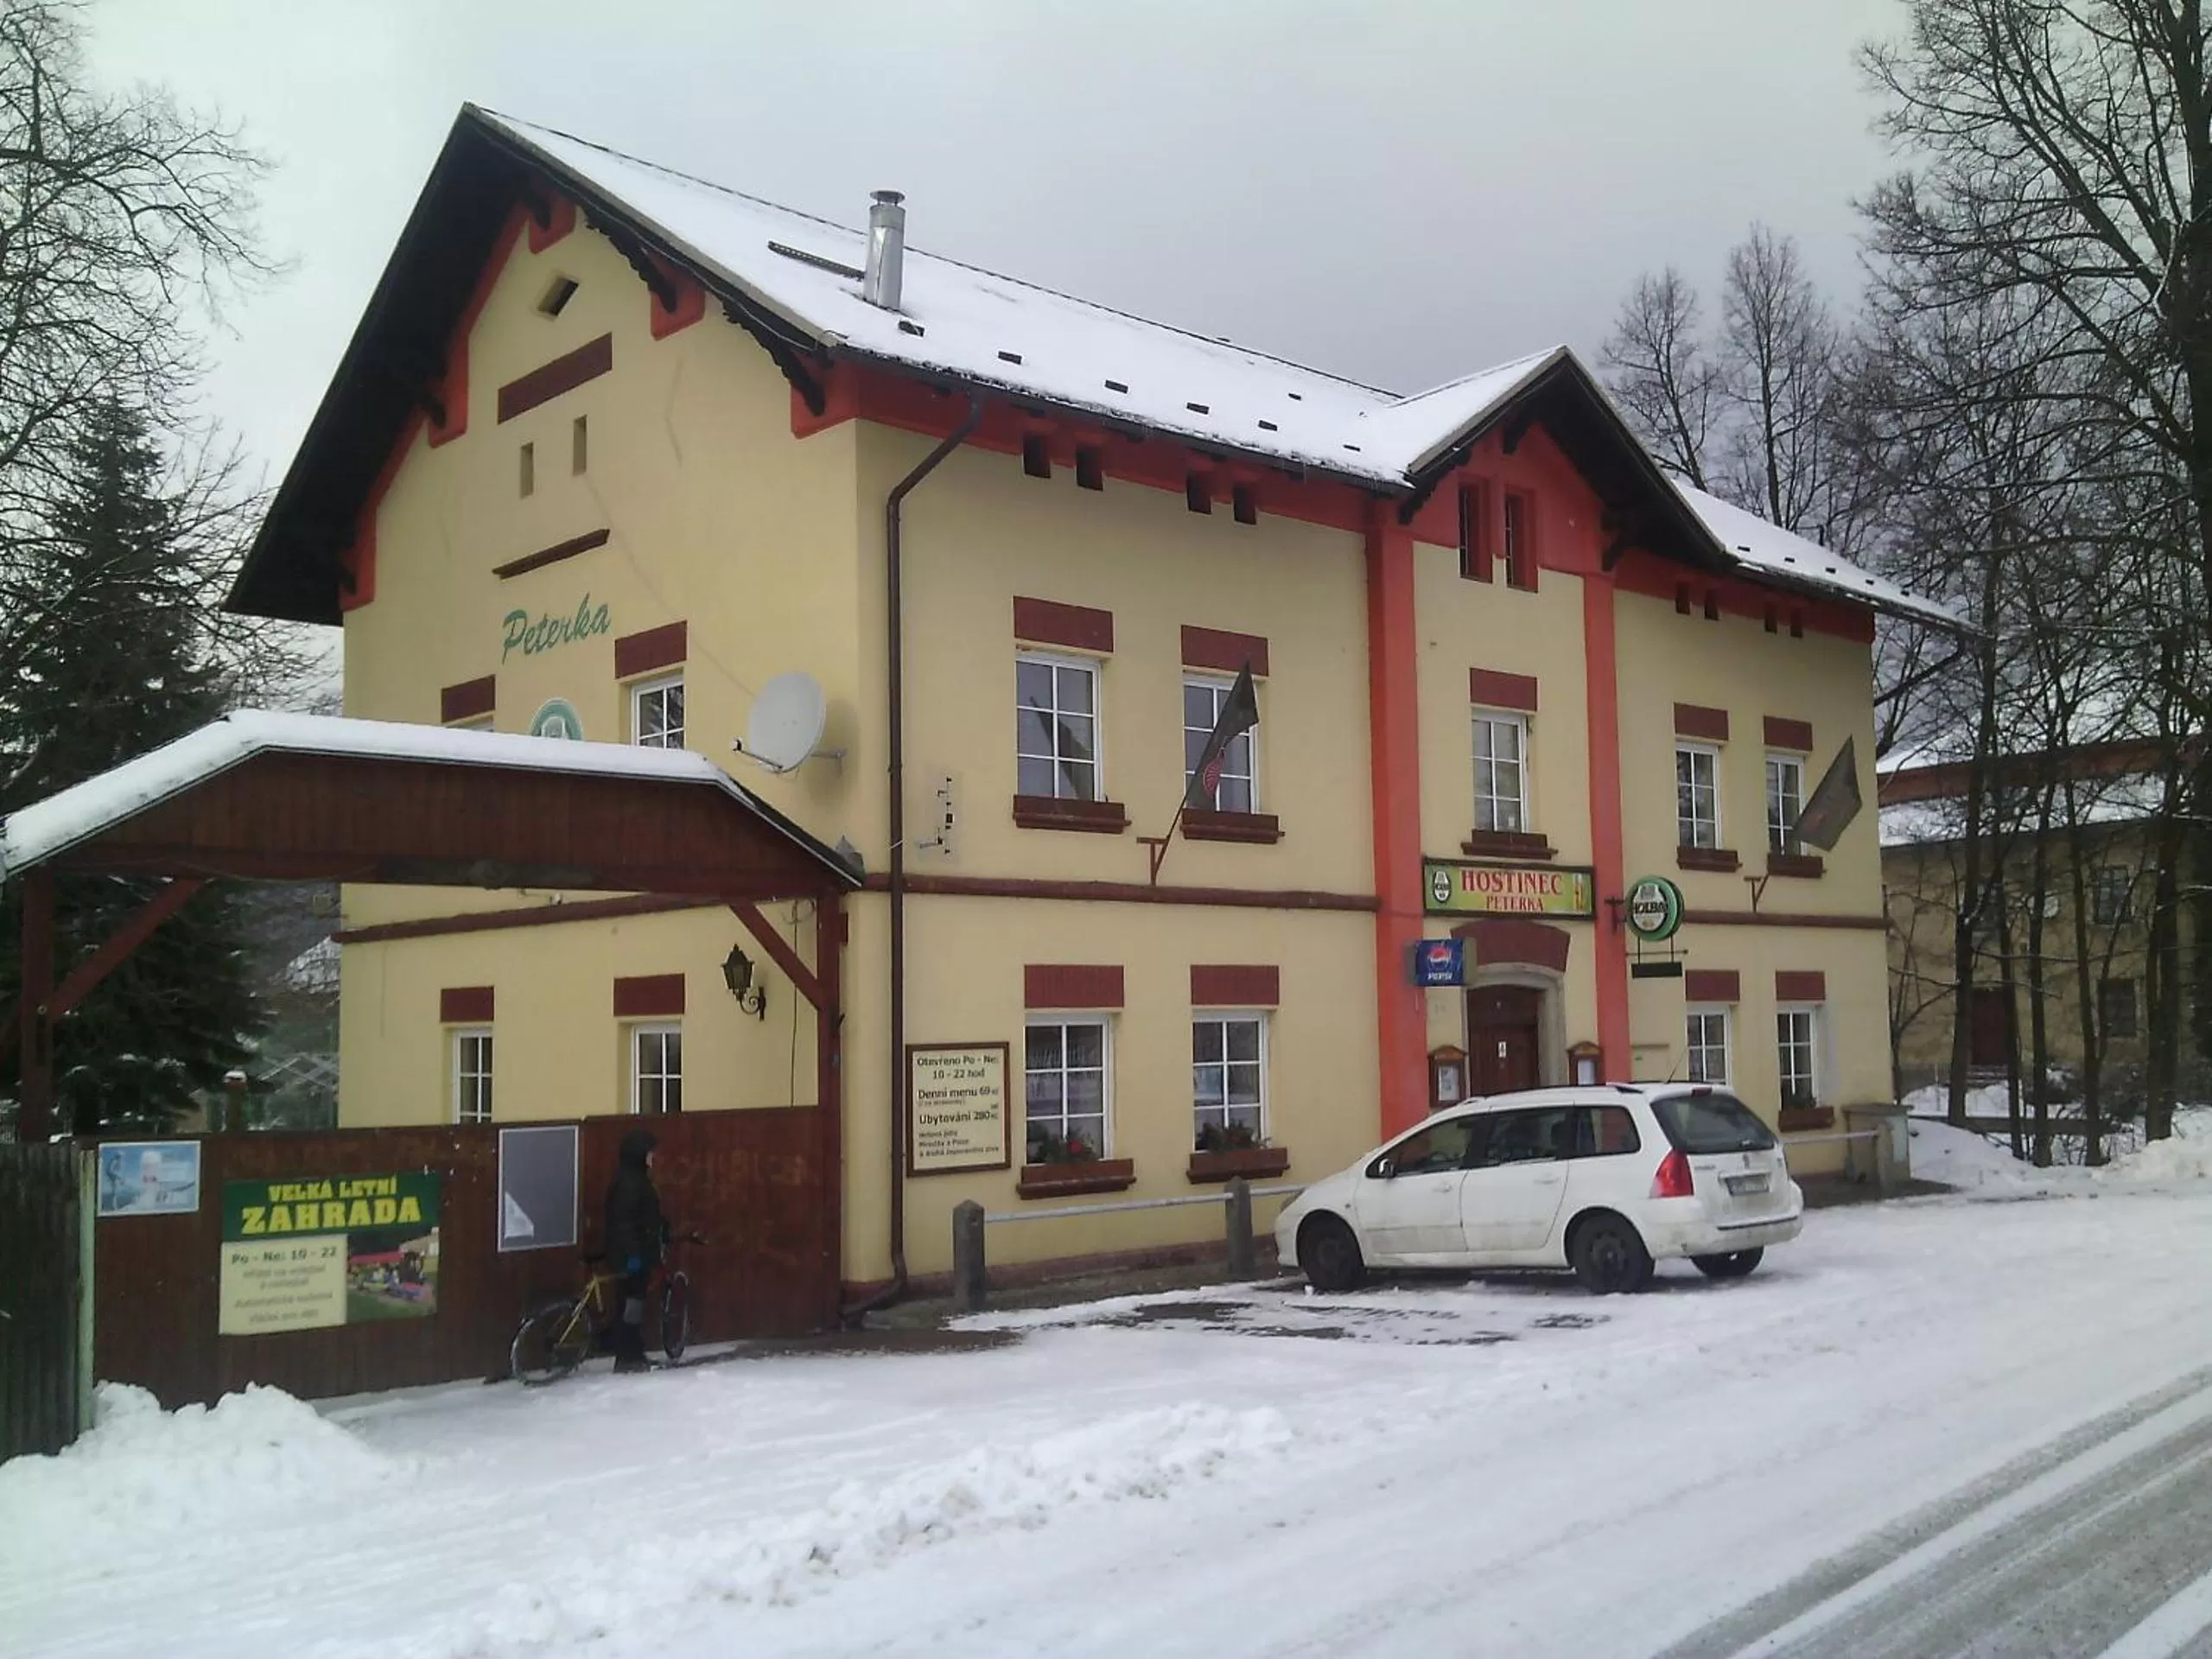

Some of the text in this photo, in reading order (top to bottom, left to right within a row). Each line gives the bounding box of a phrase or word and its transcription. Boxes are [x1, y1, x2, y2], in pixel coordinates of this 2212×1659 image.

[502, 591, 611, 665] Peterka
[1461, 869, 1563, 894] HOSTINEC
[1485, 895, 1544, 912] PETERKA
[933, 1070, 944, 1079] 10
[953, 1069, 965, 1078] 22
[950, 1089, 977, 1097] menu
[918, 1111, 971, 1125] Ubytování
[269, 1179, 333, 1201] VELKÁ
[241, 1196, 422, 1234] ZAHRADA
